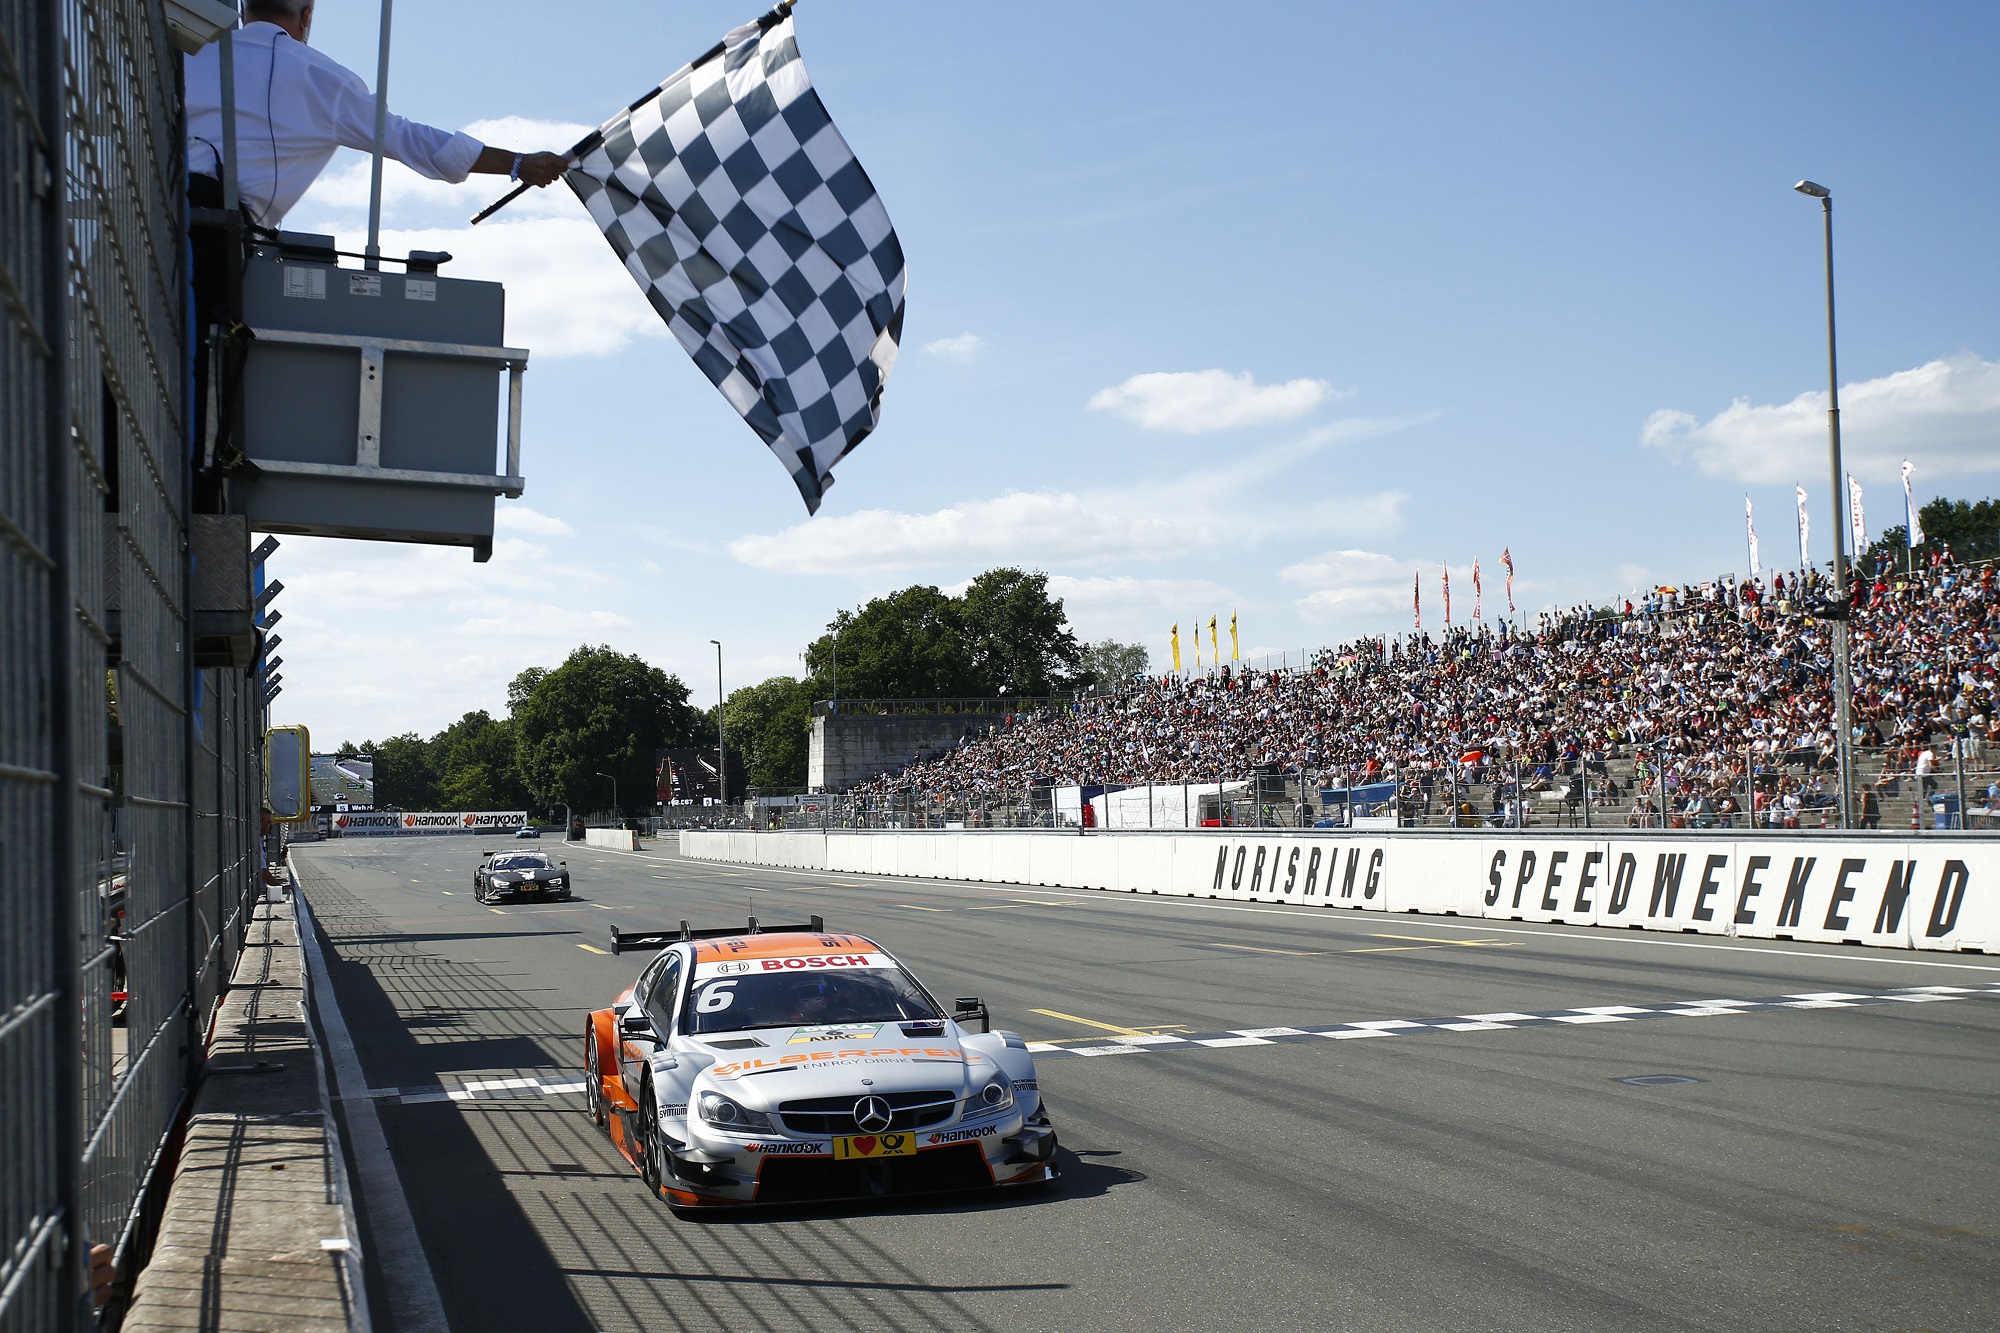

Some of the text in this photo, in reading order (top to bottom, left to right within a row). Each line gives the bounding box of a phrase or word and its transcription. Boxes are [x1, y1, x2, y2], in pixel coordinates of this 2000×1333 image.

[349, 816, 399, 828] HANKOOK
[414, 815, 458, 826] HANKOOK
[475, 814, 525, 825] HANKOOK
[495, 857, 513, 867] 27
[1213, 845, 1384, 900] NORISRING
[1484, 849, 1970, 938] SPEEDWEEKEND
[760, 955, 870, 971] BOSCH
[695, 979, 740, 1014] 6
[803, 1024, 877, 1033] DEKRA
[809, 1034, 857, 1043] ADAC
[713, 1048, 982, 1076] SILBERPFEIL
[803, 1057, 910, 1069] ENERGY DRINK
[659, 1107, 688, 1119] SYNTIUM
[940, 1124, 998, 1143] HANKOOK
[758, 1142, 824, 1154] HANKOOK
